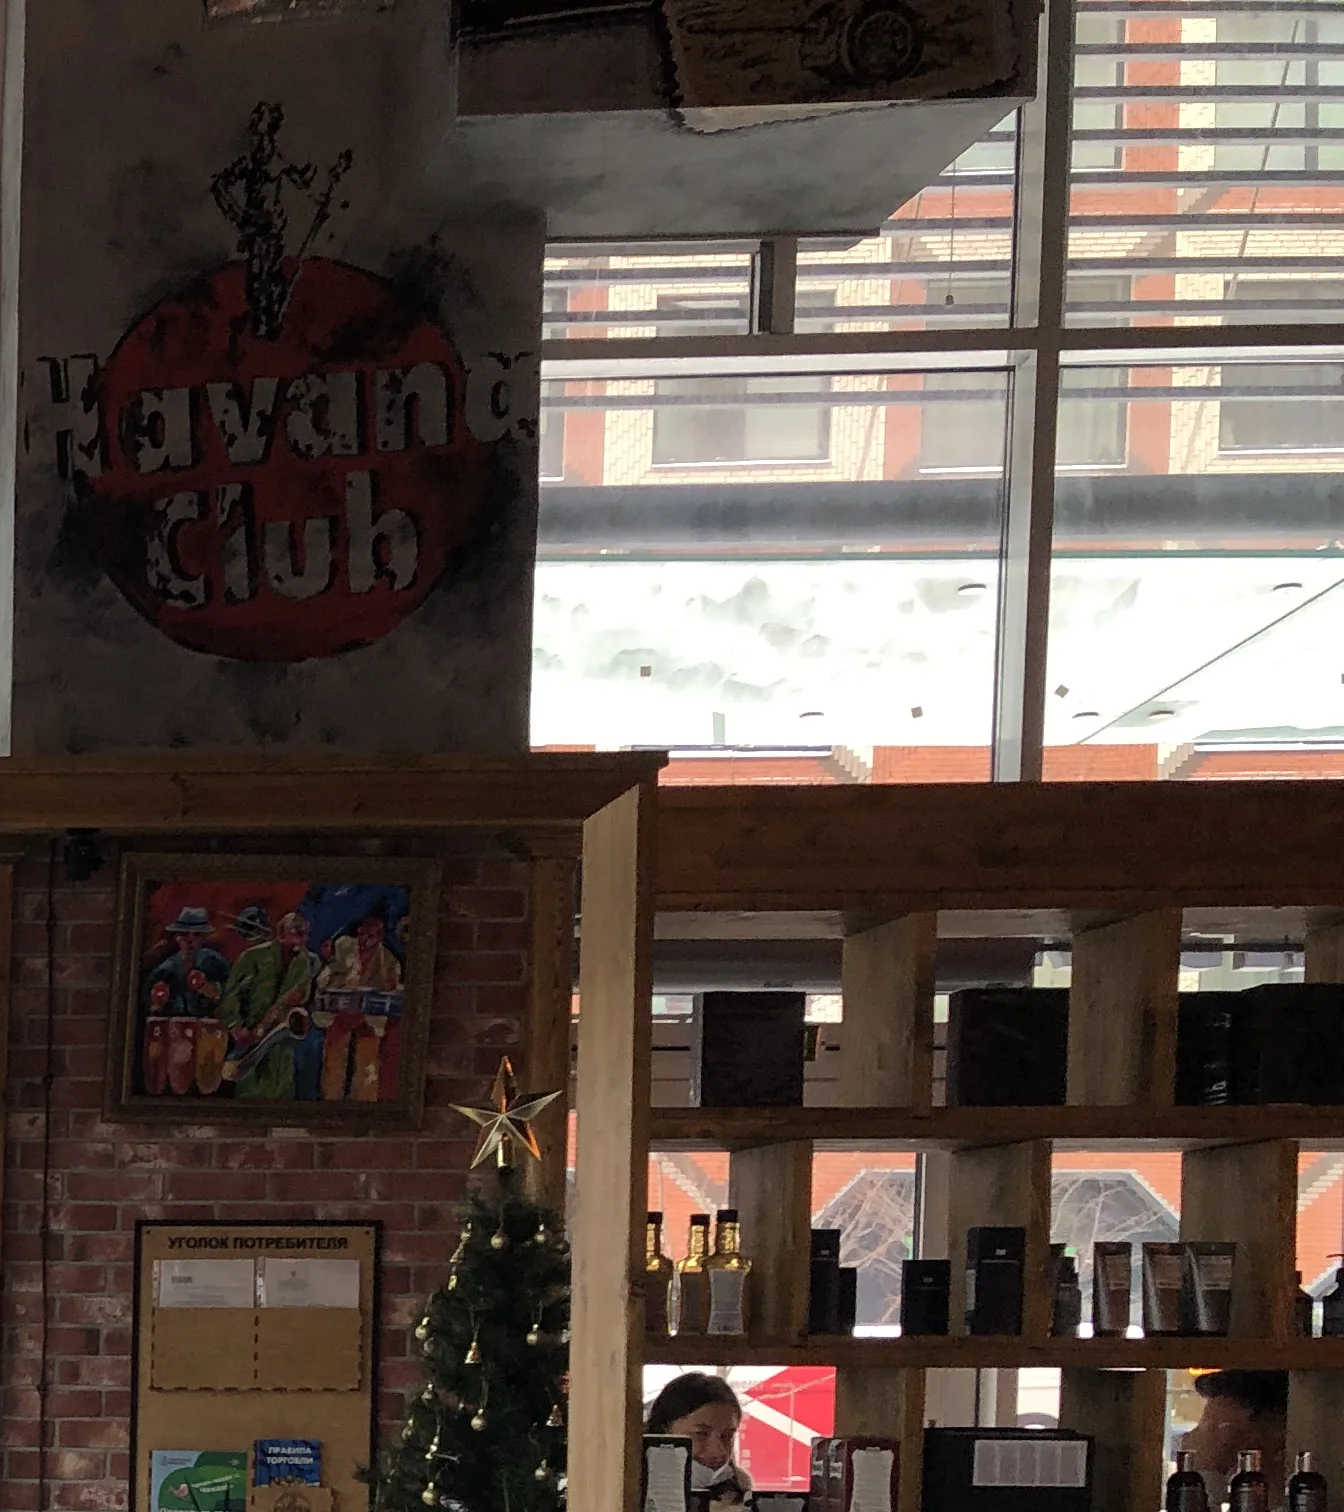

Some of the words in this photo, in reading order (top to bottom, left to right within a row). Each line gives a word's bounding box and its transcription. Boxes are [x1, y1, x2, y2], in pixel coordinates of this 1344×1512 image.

[145, 470, 420, 608] Club
[168, 1236, 228, 1249] УГОЛОК
[233, 1236, 349, 1250] ПОТРЕБИТЕЛЯ
[268, 1446, 312, 1455] ПРАВИЛА
[265, 1457, 314, 1465] ТОРГОВЛИ
